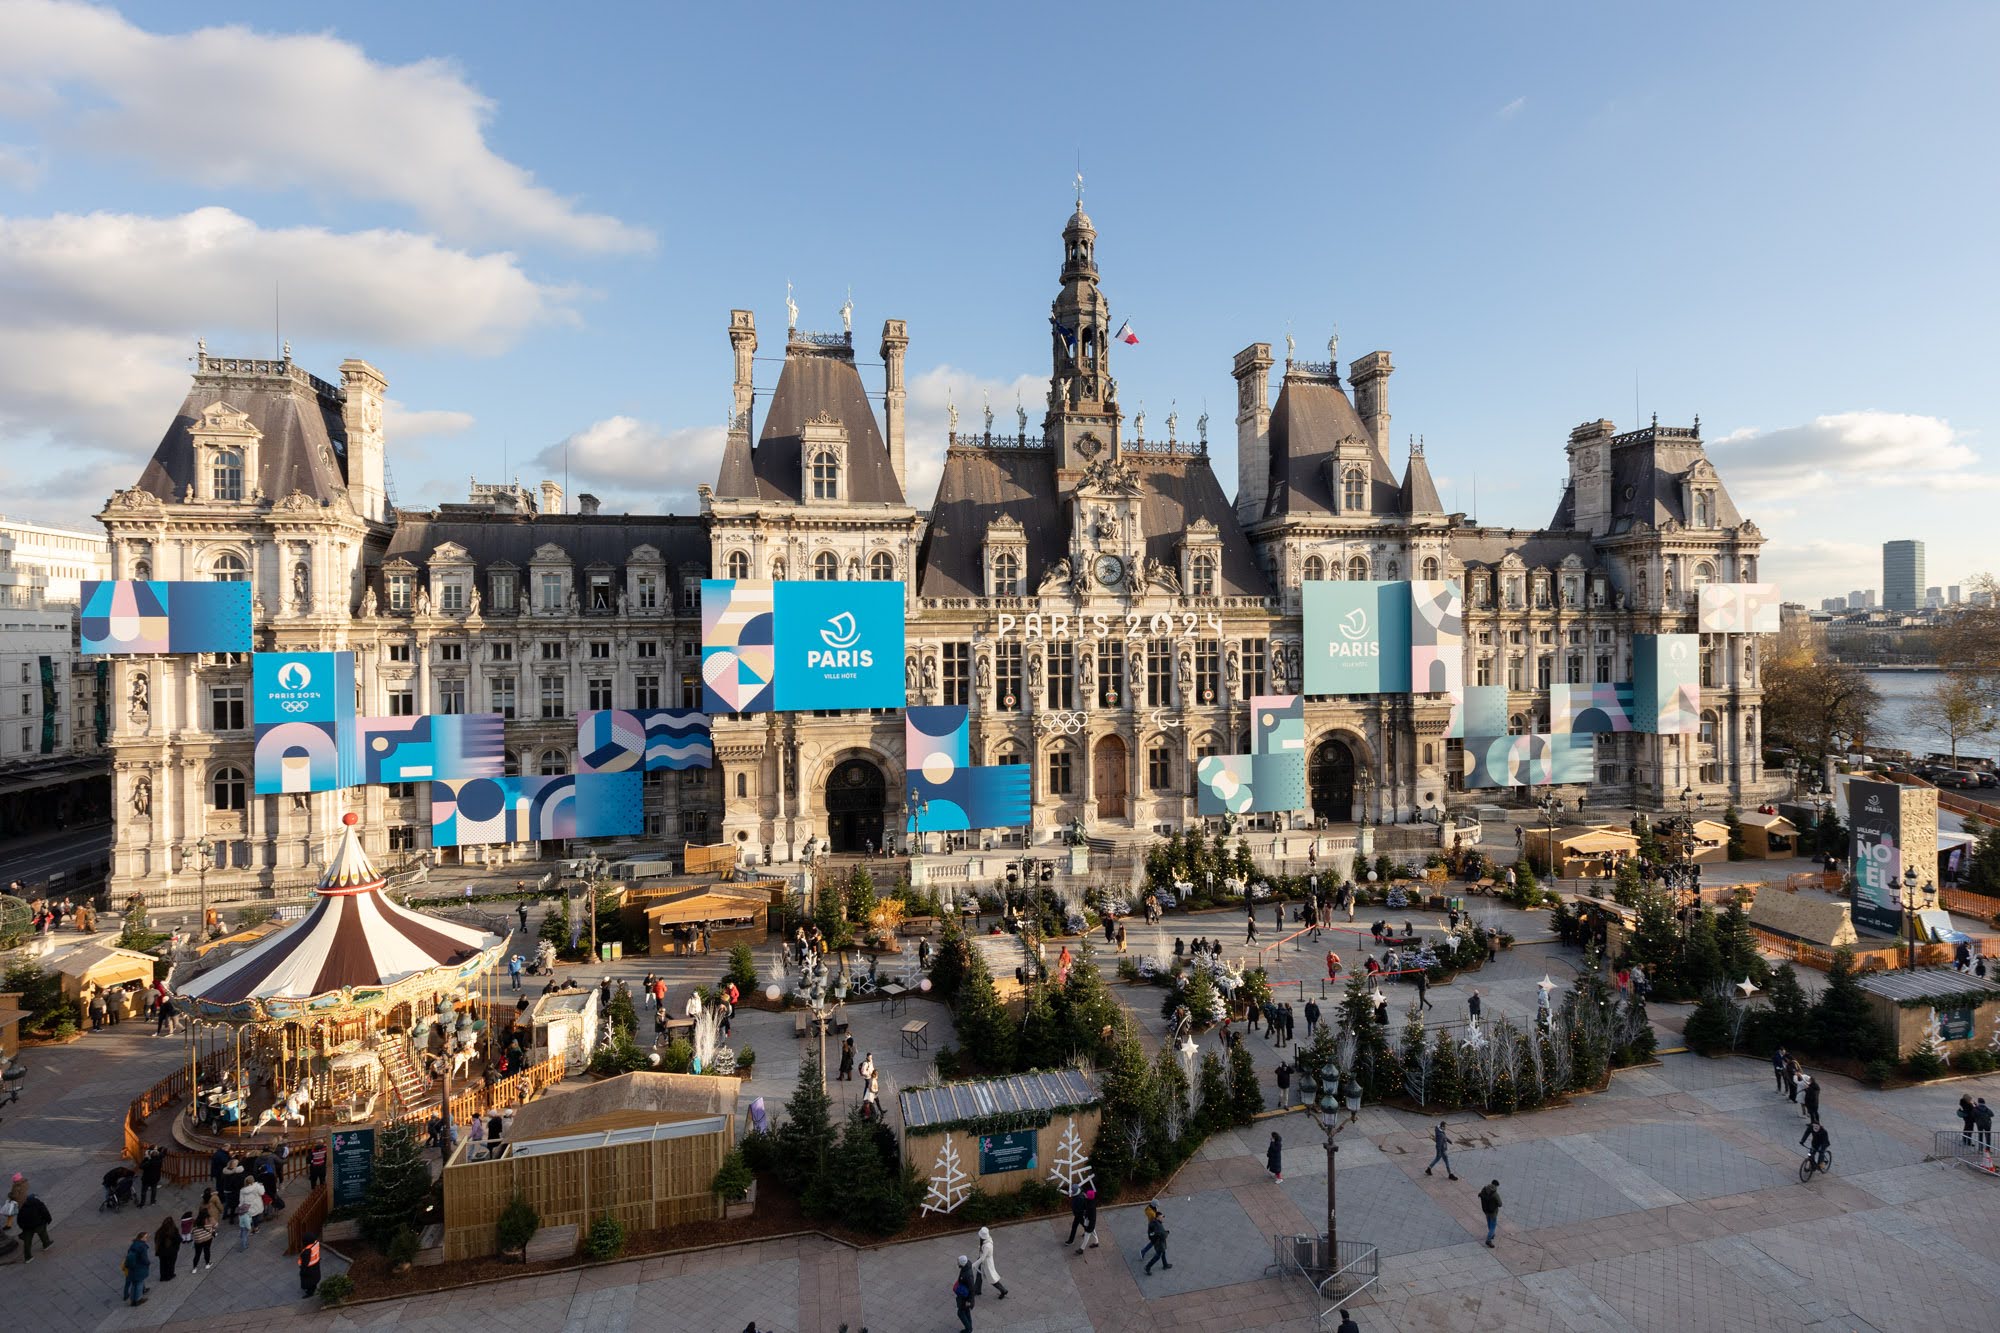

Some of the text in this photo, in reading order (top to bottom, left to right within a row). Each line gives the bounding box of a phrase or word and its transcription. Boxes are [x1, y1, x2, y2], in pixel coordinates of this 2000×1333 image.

[1125, 612, 1223, 638] 2024
[807, 650, 874, 668] PARIS
[1329, 641, 1380, 657] PARIS
[1864, 805, 1884, 814] PARIS
[1857, 840, 1892, 863] NO
[1866, 860, 1890, 889] ËL
